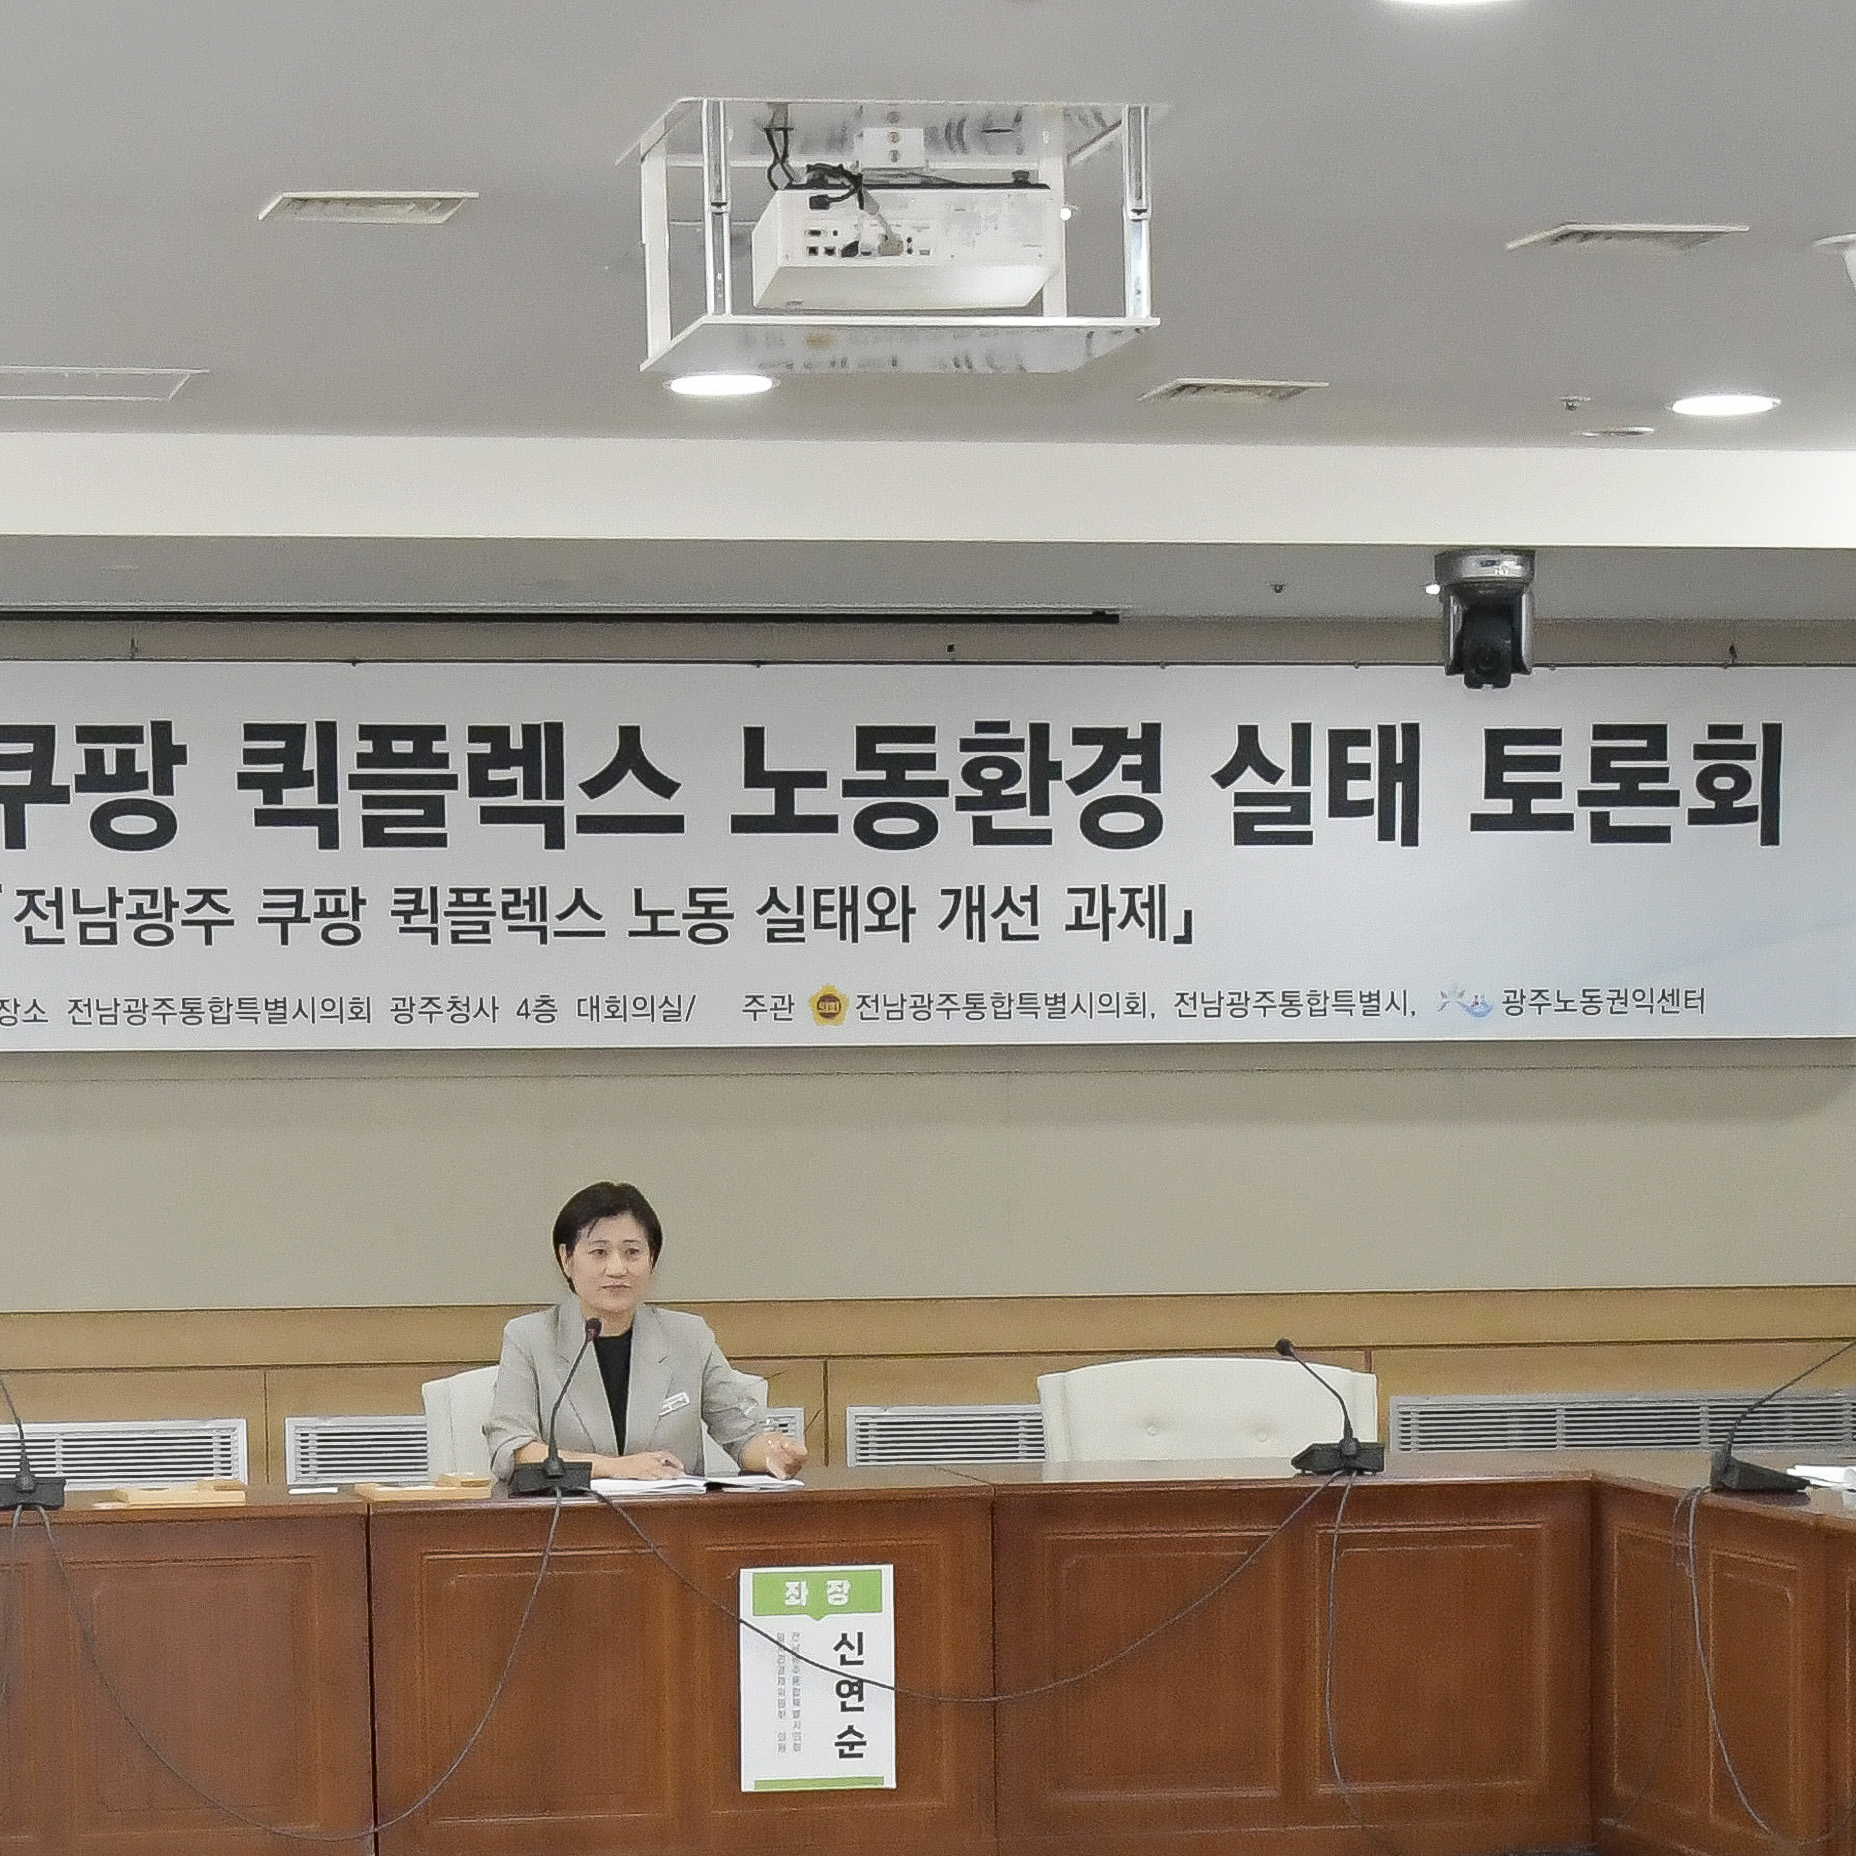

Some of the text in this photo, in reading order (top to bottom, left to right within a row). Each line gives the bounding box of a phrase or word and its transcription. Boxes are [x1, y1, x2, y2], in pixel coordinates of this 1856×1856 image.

[236, 720, 685, 851] 퀵플렉스
[730, 720, 1164, 851] 노동환경
[1210, 721, 1421, 848] 실태
[1470, 722, 1783, 847] 토론회
[257, 886, 367, 947] 쿠팡
[390, 885, 606, 946] 퀵플렉스
[627, 886, 735, 946] 노동
[755, 884, 917, 944] 실태와
[937, 884, 1040, 943] 개선
[67, 996, 371, 1026] 전남광주통합특별시의회
[389, 995, 500, 1025] 광주청사
[515, 994, 558, 1024] 4층
[577, 993, 697, 1023] 대회의실/
[741, 993, 795, 1022] 주관
[855, 991, 1157, 1022] 전남광주통합특별시의회,
[1174, 989, 1417, 1019] 전남광주통합특별시,
[1502, 987, 1705, 1017] 광주노동권익센터
[833, 1631, 867, 1760] 신연순
